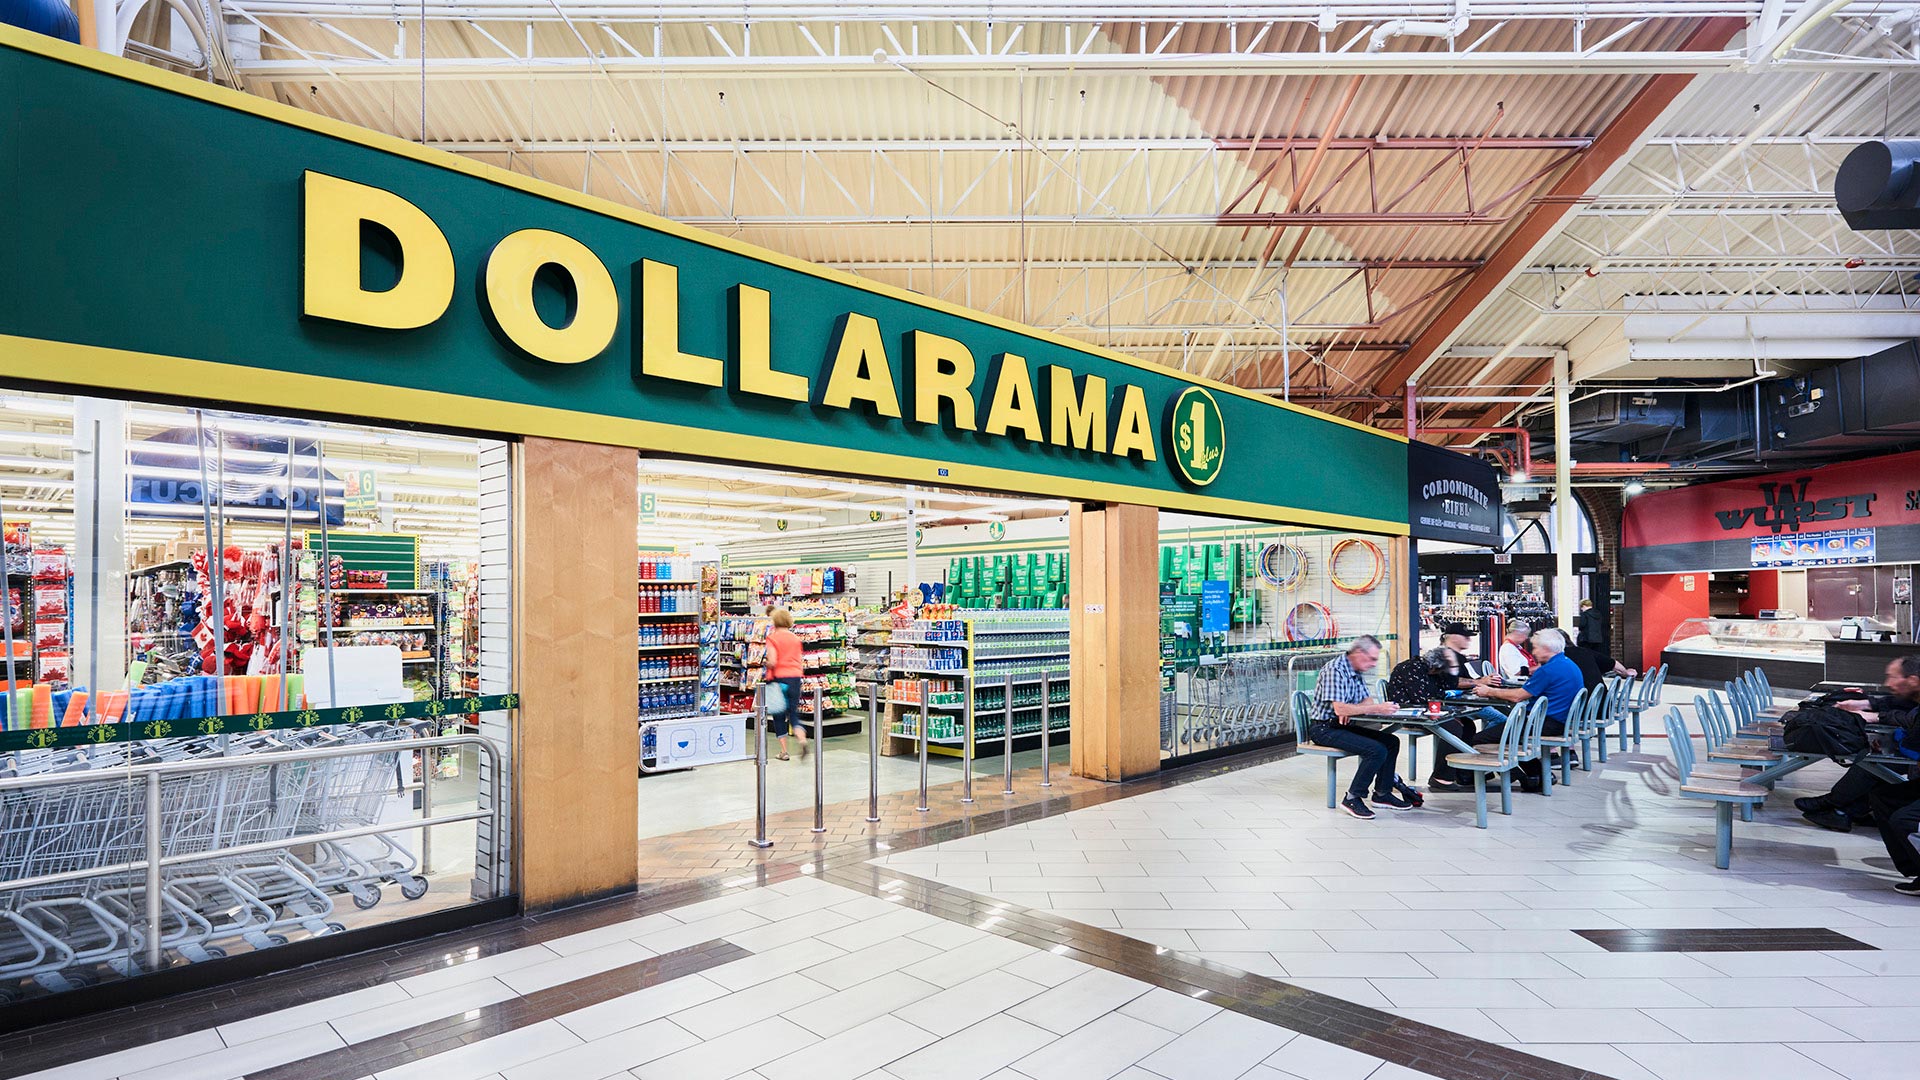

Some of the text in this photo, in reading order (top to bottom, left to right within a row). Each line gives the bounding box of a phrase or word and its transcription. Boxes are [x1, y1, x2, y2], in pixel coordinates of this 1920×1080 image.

[302, 170, 1157, 463] DOLLARAMA
[363, 472, 372, 493] 6
[1422, 479, 1489, 510] CORDONNERIE
[643, 495, 653, 511] 5
[1715, 493, 1877, 531] WURST
